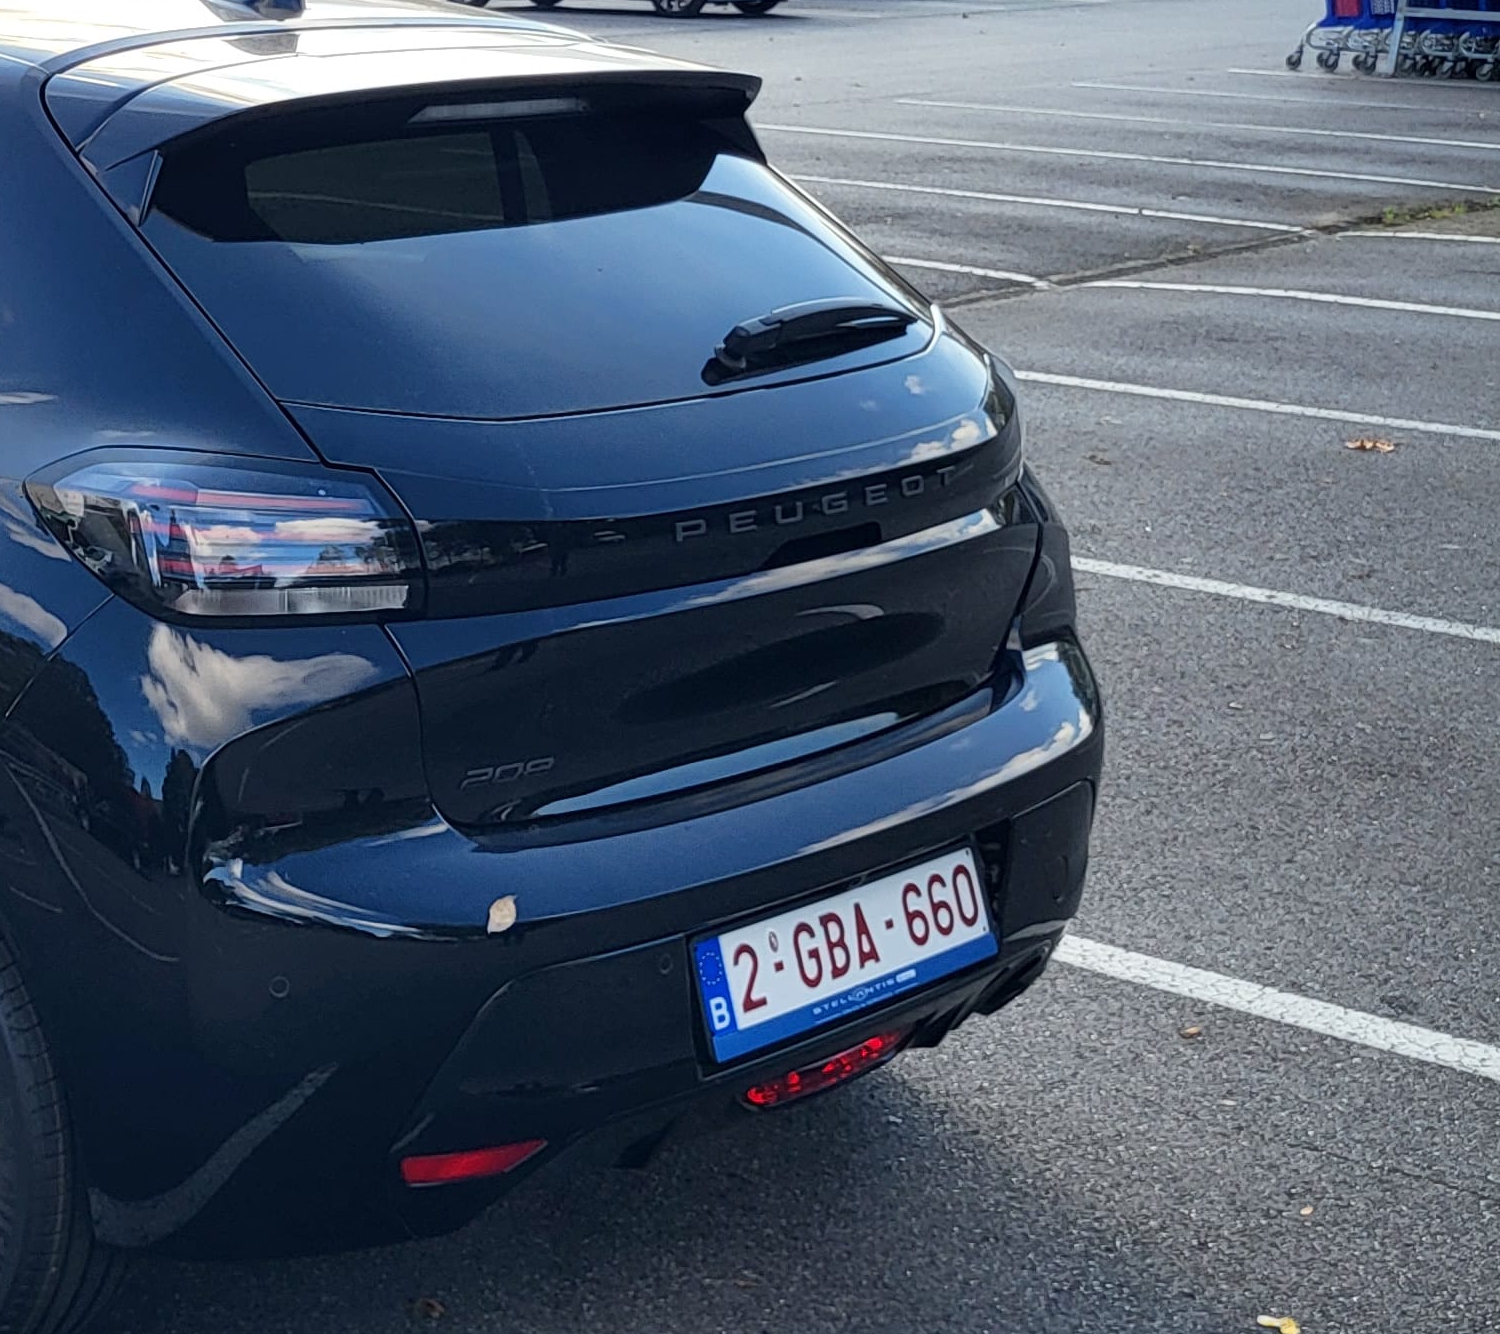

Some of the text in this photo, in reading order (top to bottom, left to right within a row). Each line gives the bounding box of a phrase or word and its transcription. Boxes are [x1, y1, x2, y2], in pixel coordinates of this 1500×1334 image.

[675, 466, 956, 543] PEUGEOT
[460, 756, 555, 791] 208
[709, 996, 731, 1031] B
